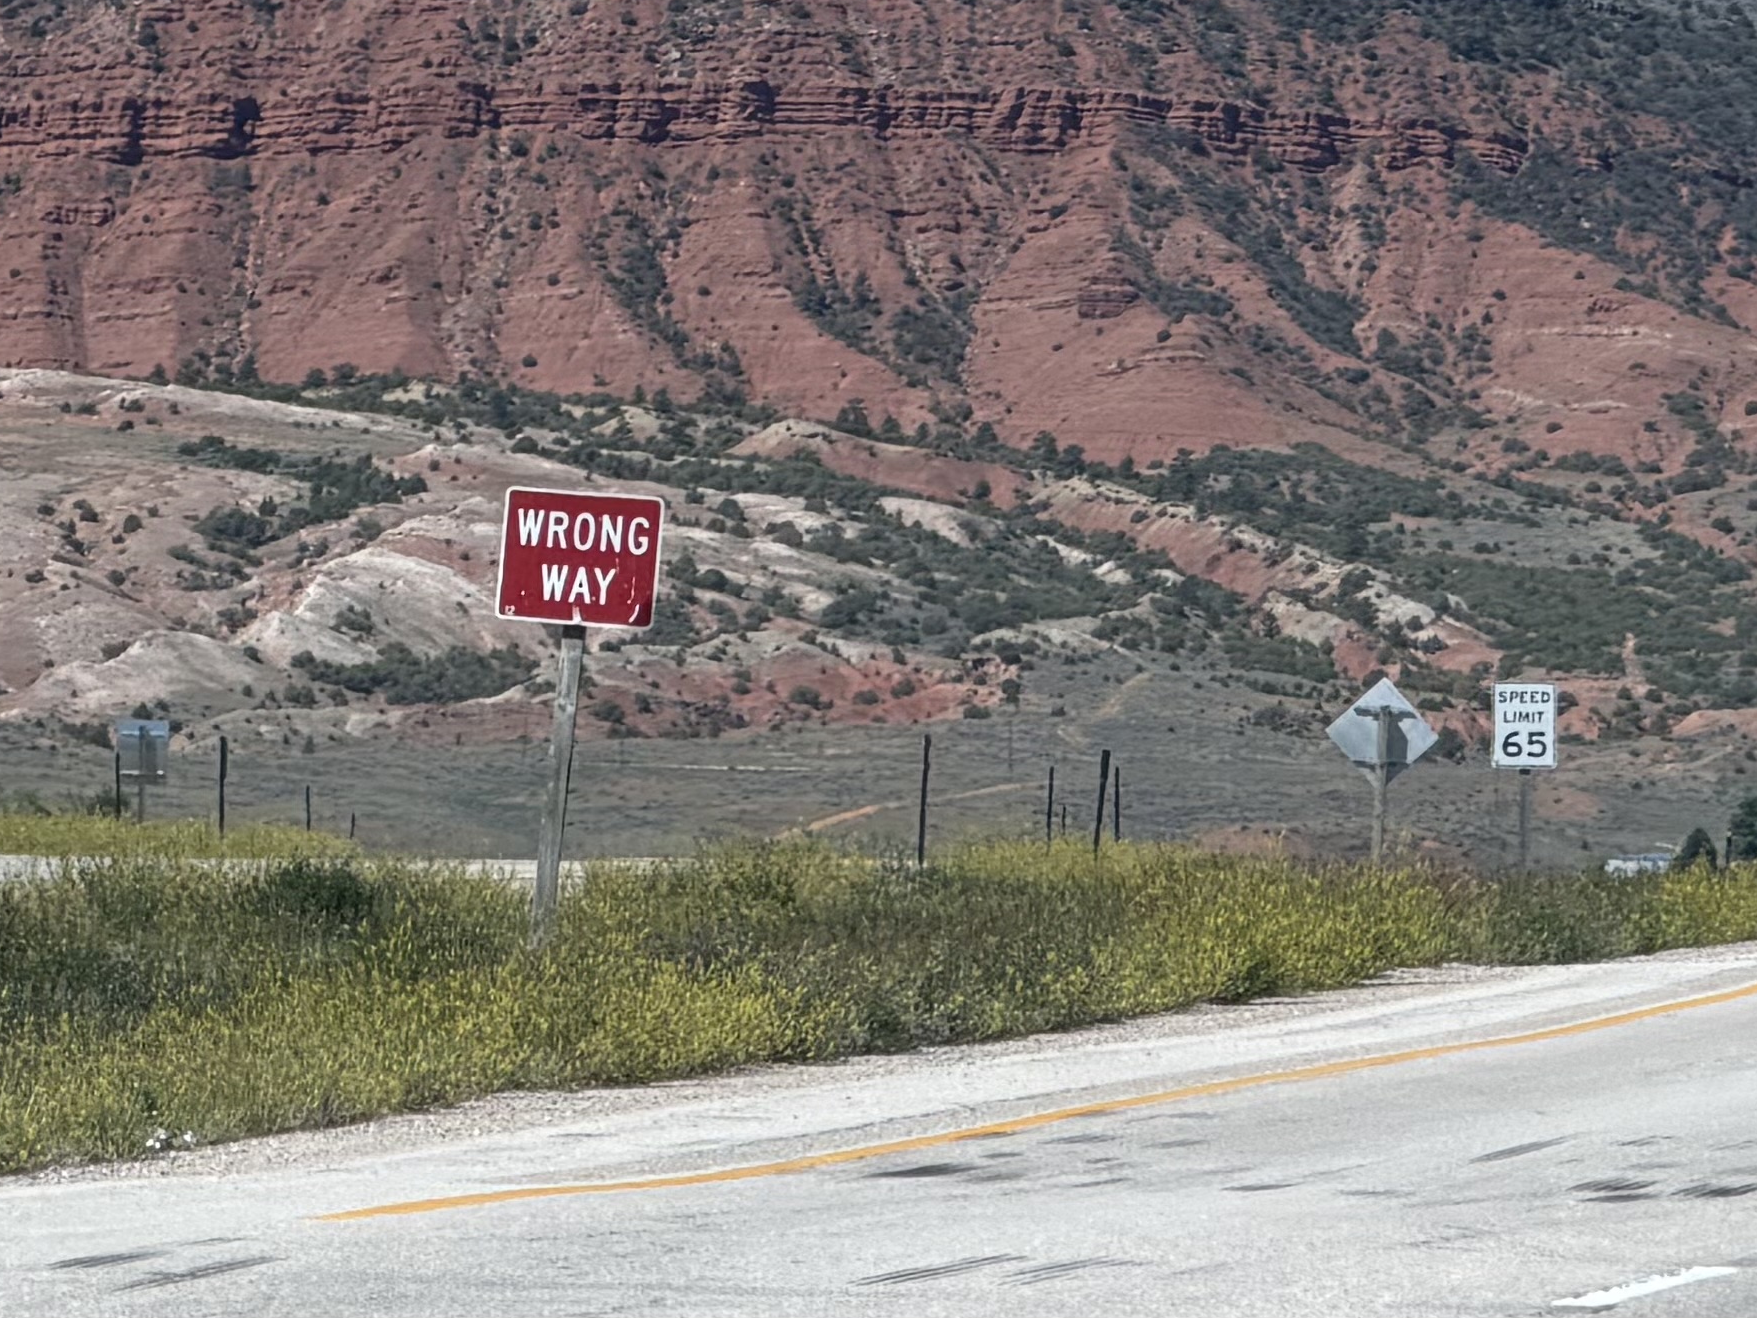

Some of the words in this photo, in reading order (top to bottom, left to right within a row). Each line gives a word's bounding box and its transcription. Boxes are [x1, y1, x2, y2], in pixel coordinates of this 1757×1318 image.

[517, 508, 650, 556] WRONG
[541, 563, 617, 605] WAY
[1498, 691, 1551, 704] SPEED
[1503, 711, 1544, 724] LIMIT
[1502, 731, 1547, 758] 65
